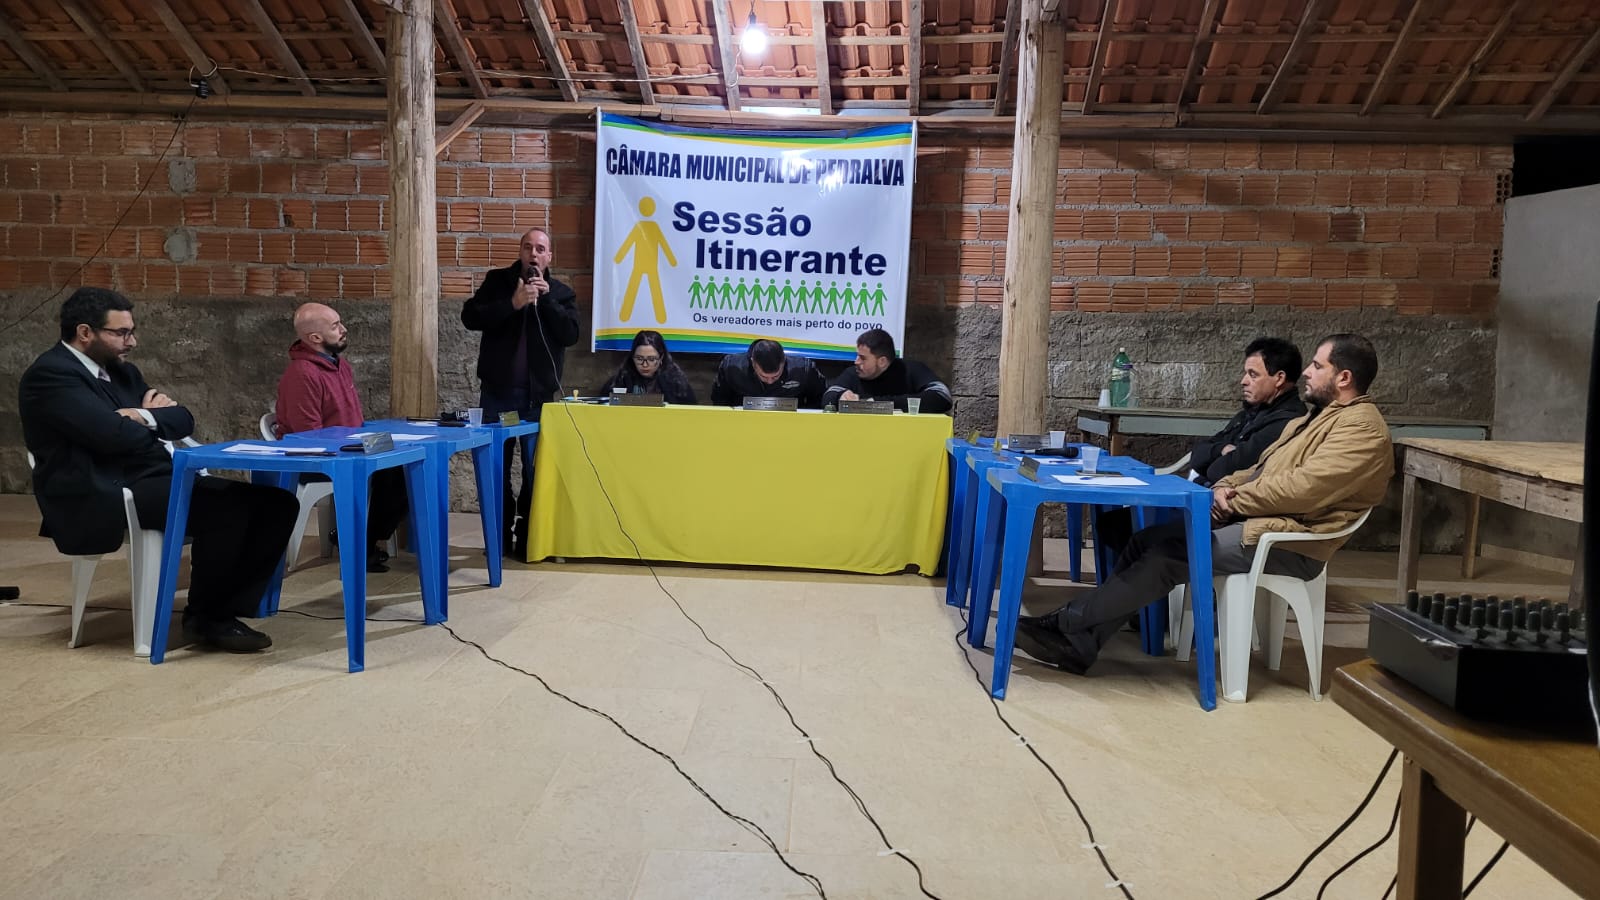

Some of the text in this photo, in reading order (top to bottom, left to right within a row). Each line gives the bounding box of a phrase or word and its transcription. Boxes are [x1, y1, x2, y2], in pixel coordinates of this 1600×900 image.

[606, 144, 681, 178] CÂMARA
[686, 154, 784, 183] MUNICIPAL
[672, 201, 812, 237] Sessão
[696, 239, 887, 276] Itinerante
[693, 313, 882, 332] Os vereadores mais perto do povo
